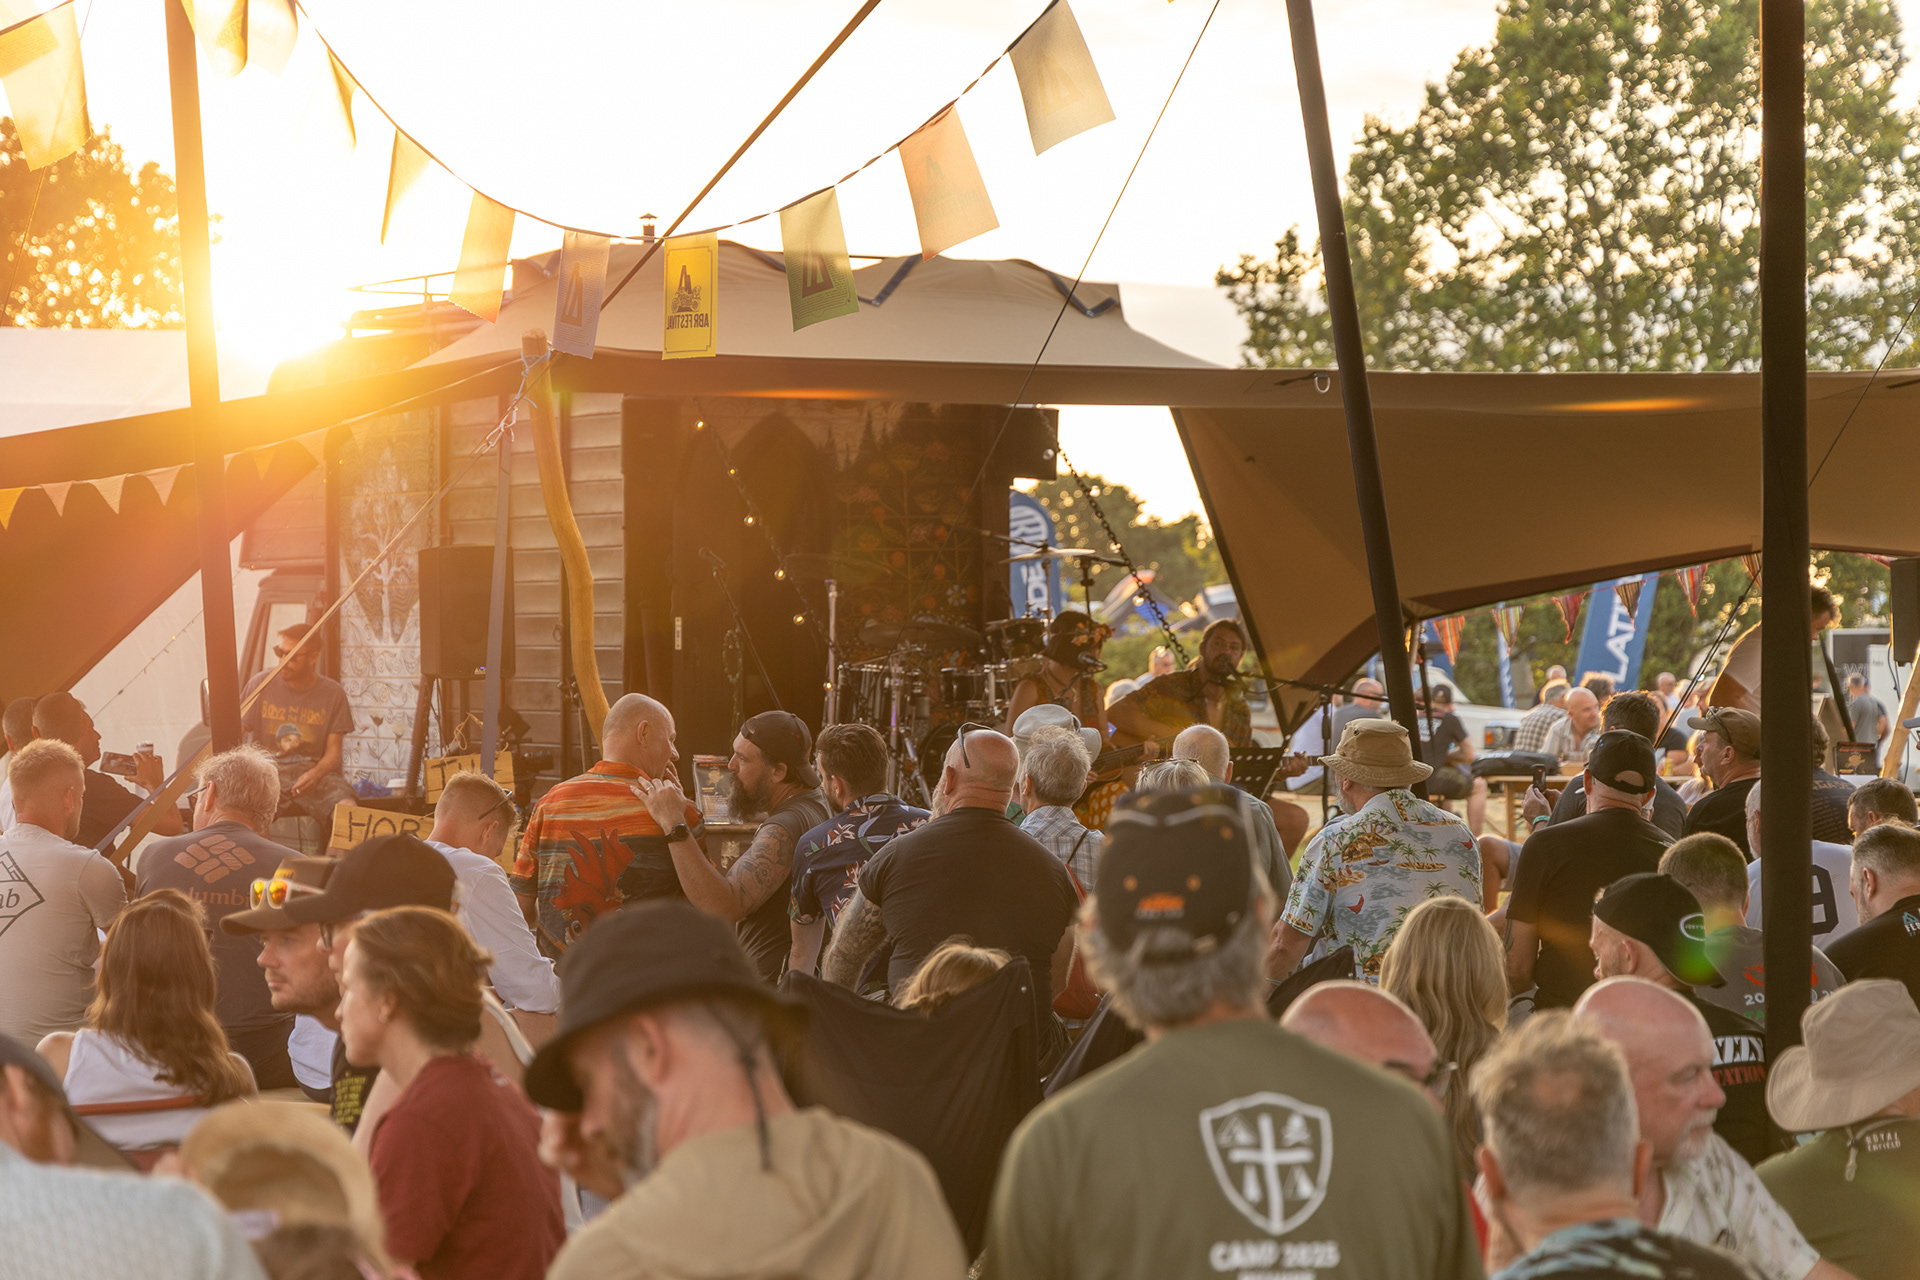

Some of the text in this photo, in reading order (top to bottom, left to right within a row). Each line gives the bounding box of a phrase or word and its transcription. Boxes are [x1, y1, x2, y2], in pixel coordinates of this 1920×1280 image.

[188, 886, 250, 908] lumbi
[1713, 1065, 1767, 1087] TATION
[1865, 1131, 1898, 1143] ROYAL
[1866, 1140, 1901, 1152] ENFIELD
[1209, 1239, 1279, 1272] CAMP
